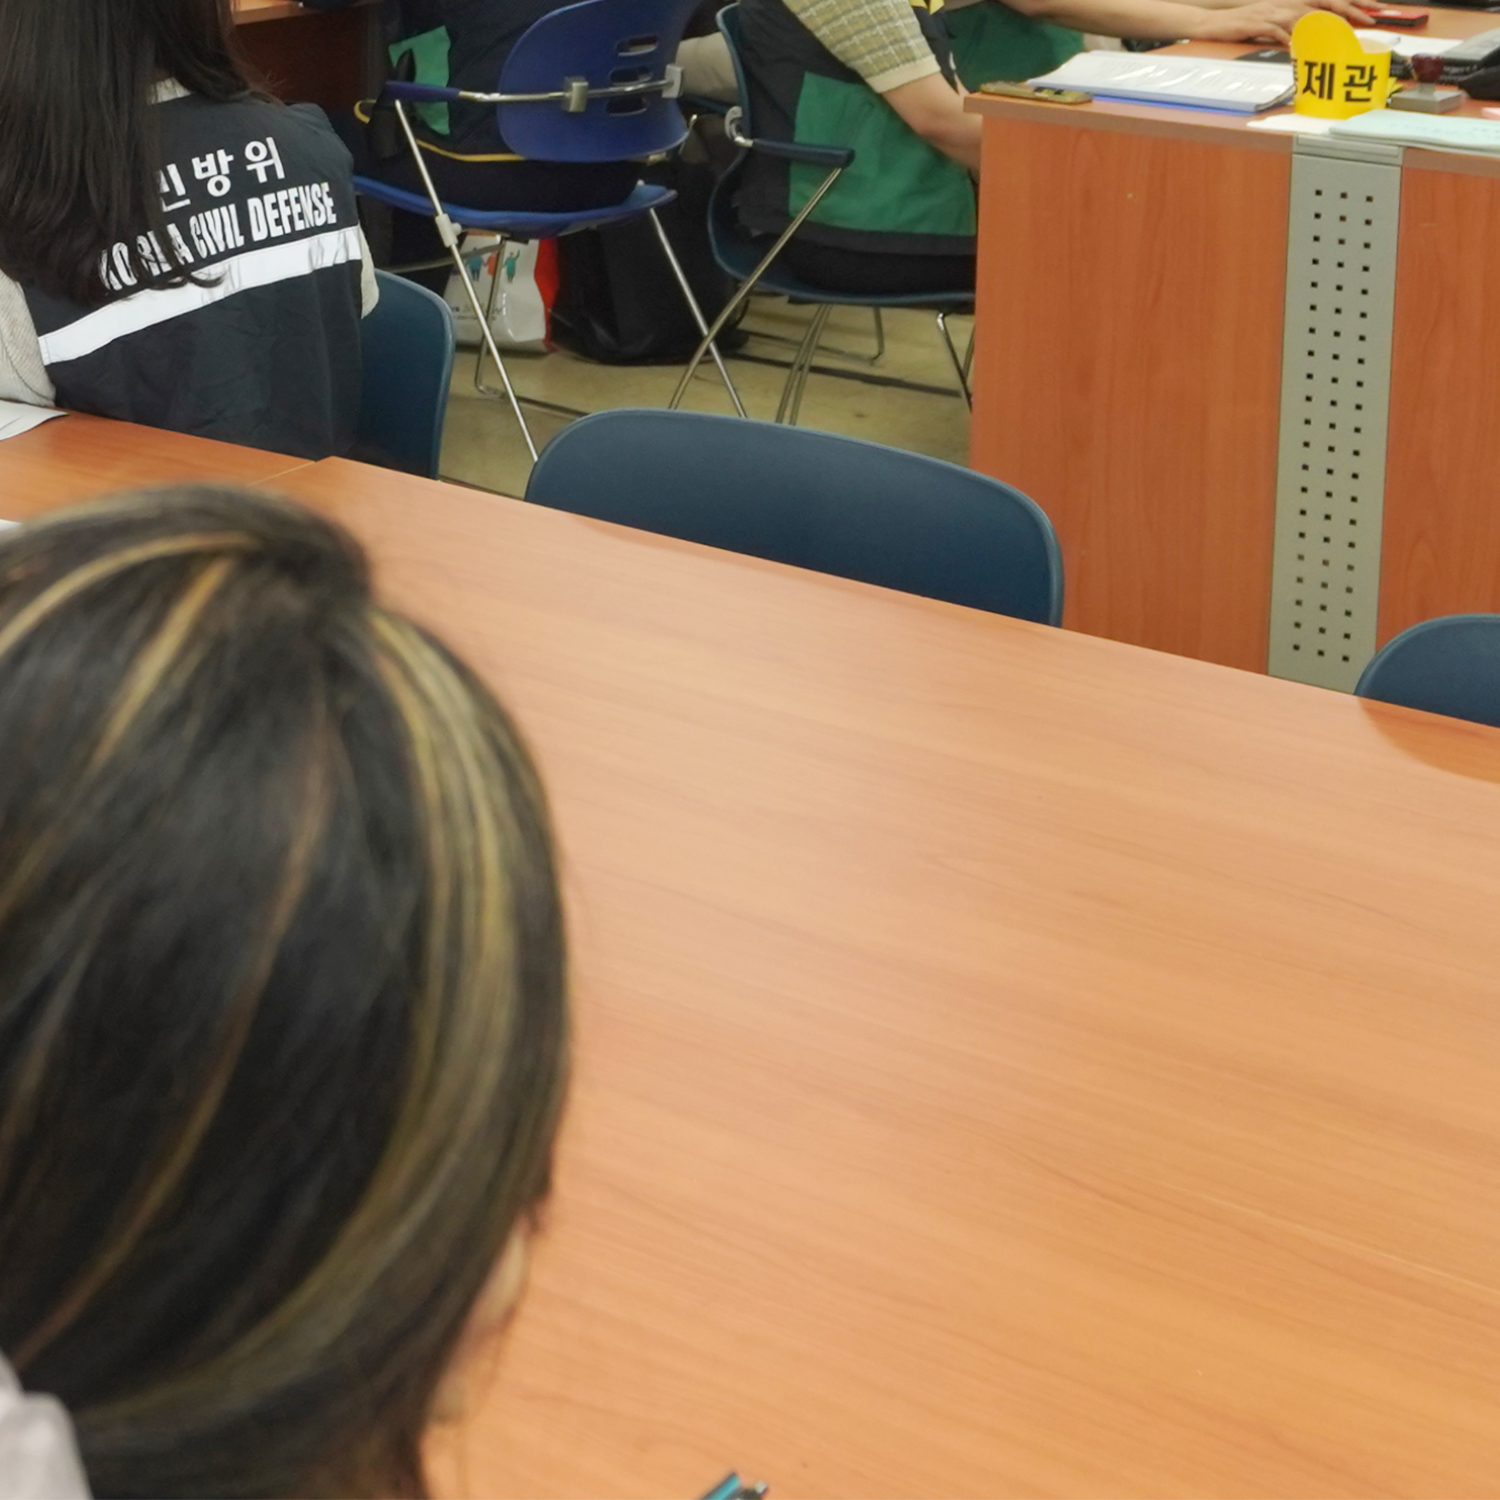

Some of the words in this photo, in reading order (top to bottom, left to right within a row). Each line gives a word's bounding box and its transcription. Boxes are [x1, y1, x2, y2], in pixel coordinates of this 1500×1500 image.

[1294, 57, 1378, 103] 제관
[188, 203, 245, 260] CIVIL
[246, 182, 337, 243] DEFENSE
